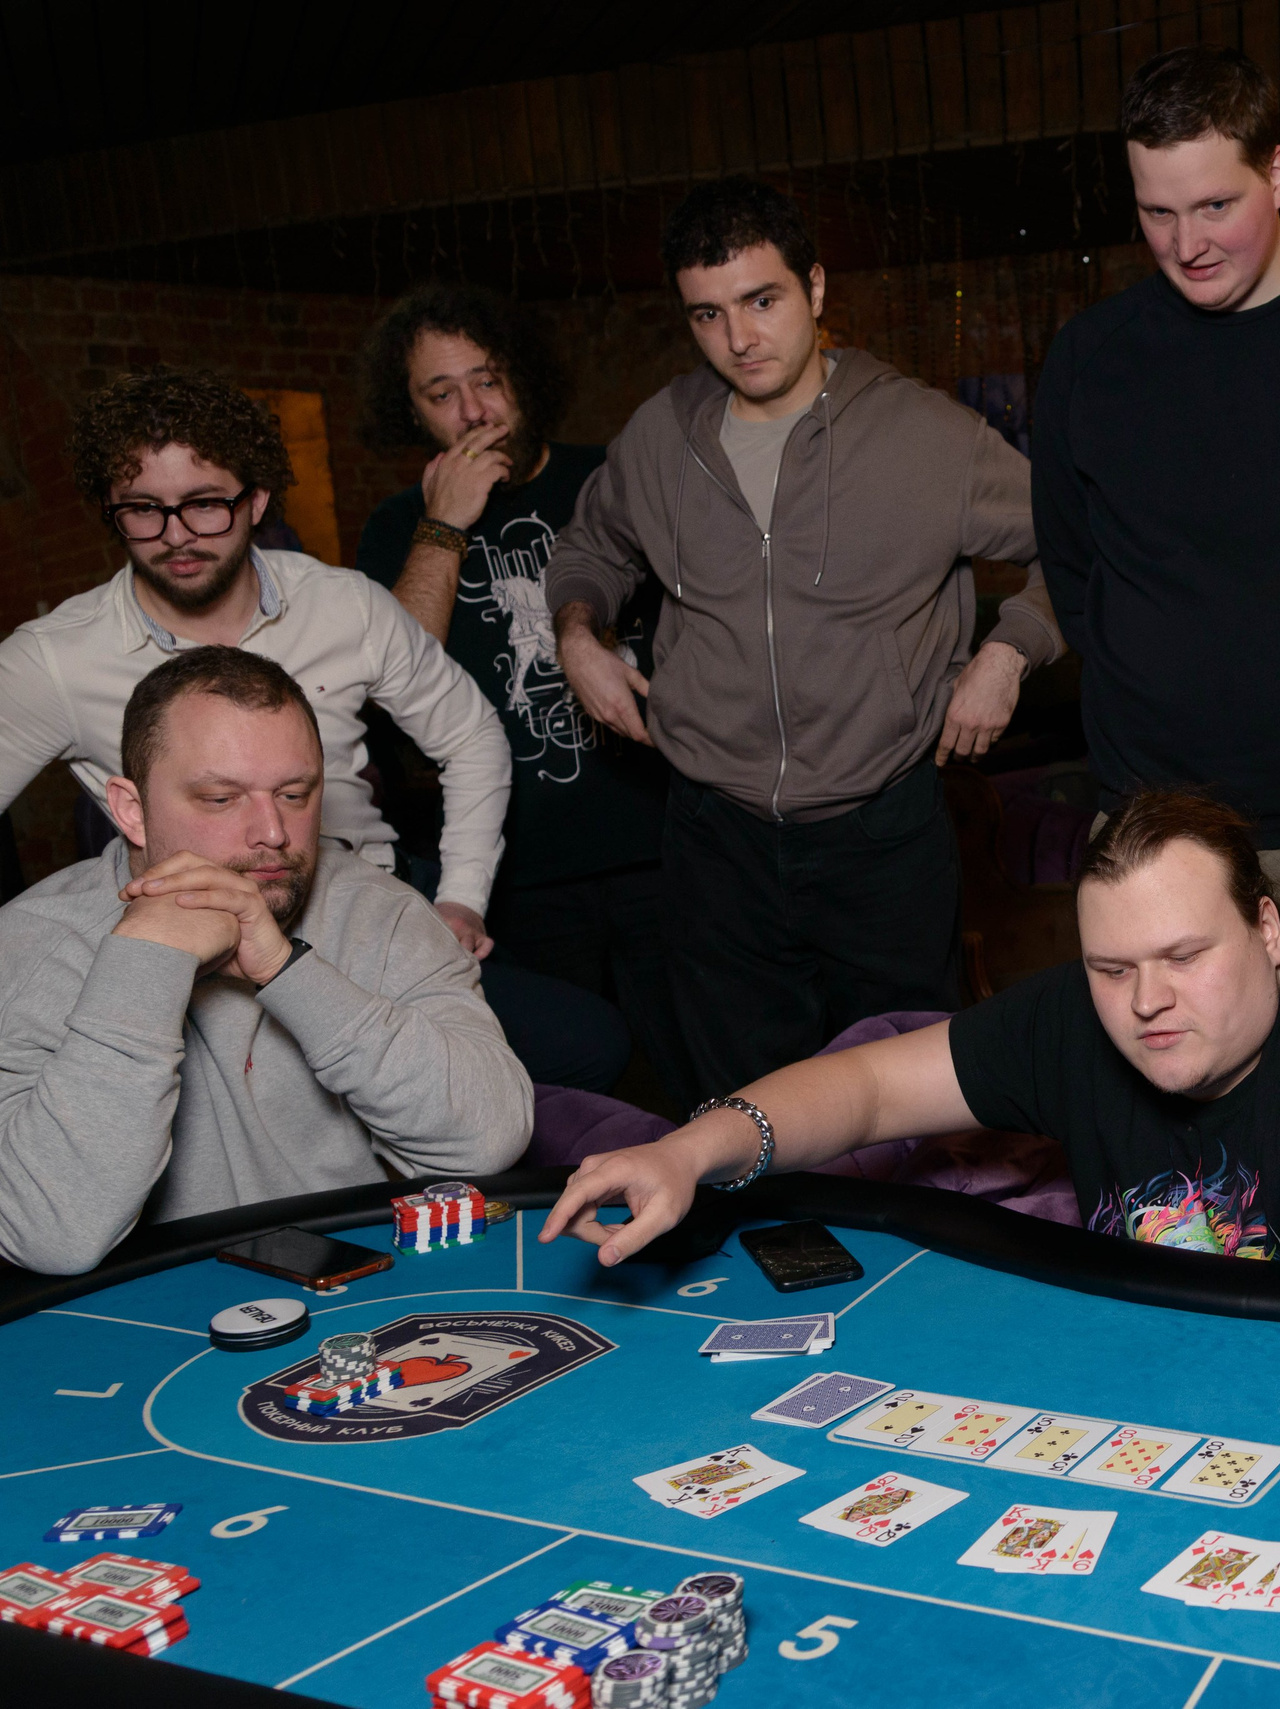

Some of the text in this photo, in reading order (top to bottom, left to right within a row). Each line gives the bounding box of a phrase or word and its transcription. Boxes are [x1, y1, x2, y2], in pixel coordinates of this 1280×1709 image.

[239, 1304, 277, 1323] DEALER
[419, 1320, 577, 1352] ВОСЬМЁРКА КИКЕР
[895, 1392, 914, 1402] 2
[961, 1404, 979, 1414] 6
[257, 1401, 404, 1435] ПОКЕРНЫЙ КЛУБ
[1037, 1416, 1056, 1427] 5
[894, 1433, 915, 1444] 2
[1118, 1429, 1137, 1439] 8
[726, 1445, 751, 1457] K
[970, 1446, 989, 1456] 6
[1206, 1440, 1225, 1451] 8
[1048, 1461, 1068, 1472] 5
[877, 1475, 898, 1487] Q
[1133, 1474, 1153, 1485] 8
[1229, 1487, 1248, 1498] 8
[667, 1493, 693, 1505] K
[699, 1503, 727, 1516] K
[1006, 1506, 1031, 1518] K
[210, 1505, 290, 1539] 6
[856, 1524, 878, 1538] Q
[875, 1529, 897, 1542] Q
[1201, 1535, 1224, 1546] J
[1028, 1558, 1054, 1571] K
[1211, 1593, 1237, 1605] J
[584, 1600, 627, 1614] 25000
[547, 1622, 586, 1639] 10000
[778, 1614, 859, 1661] 5
